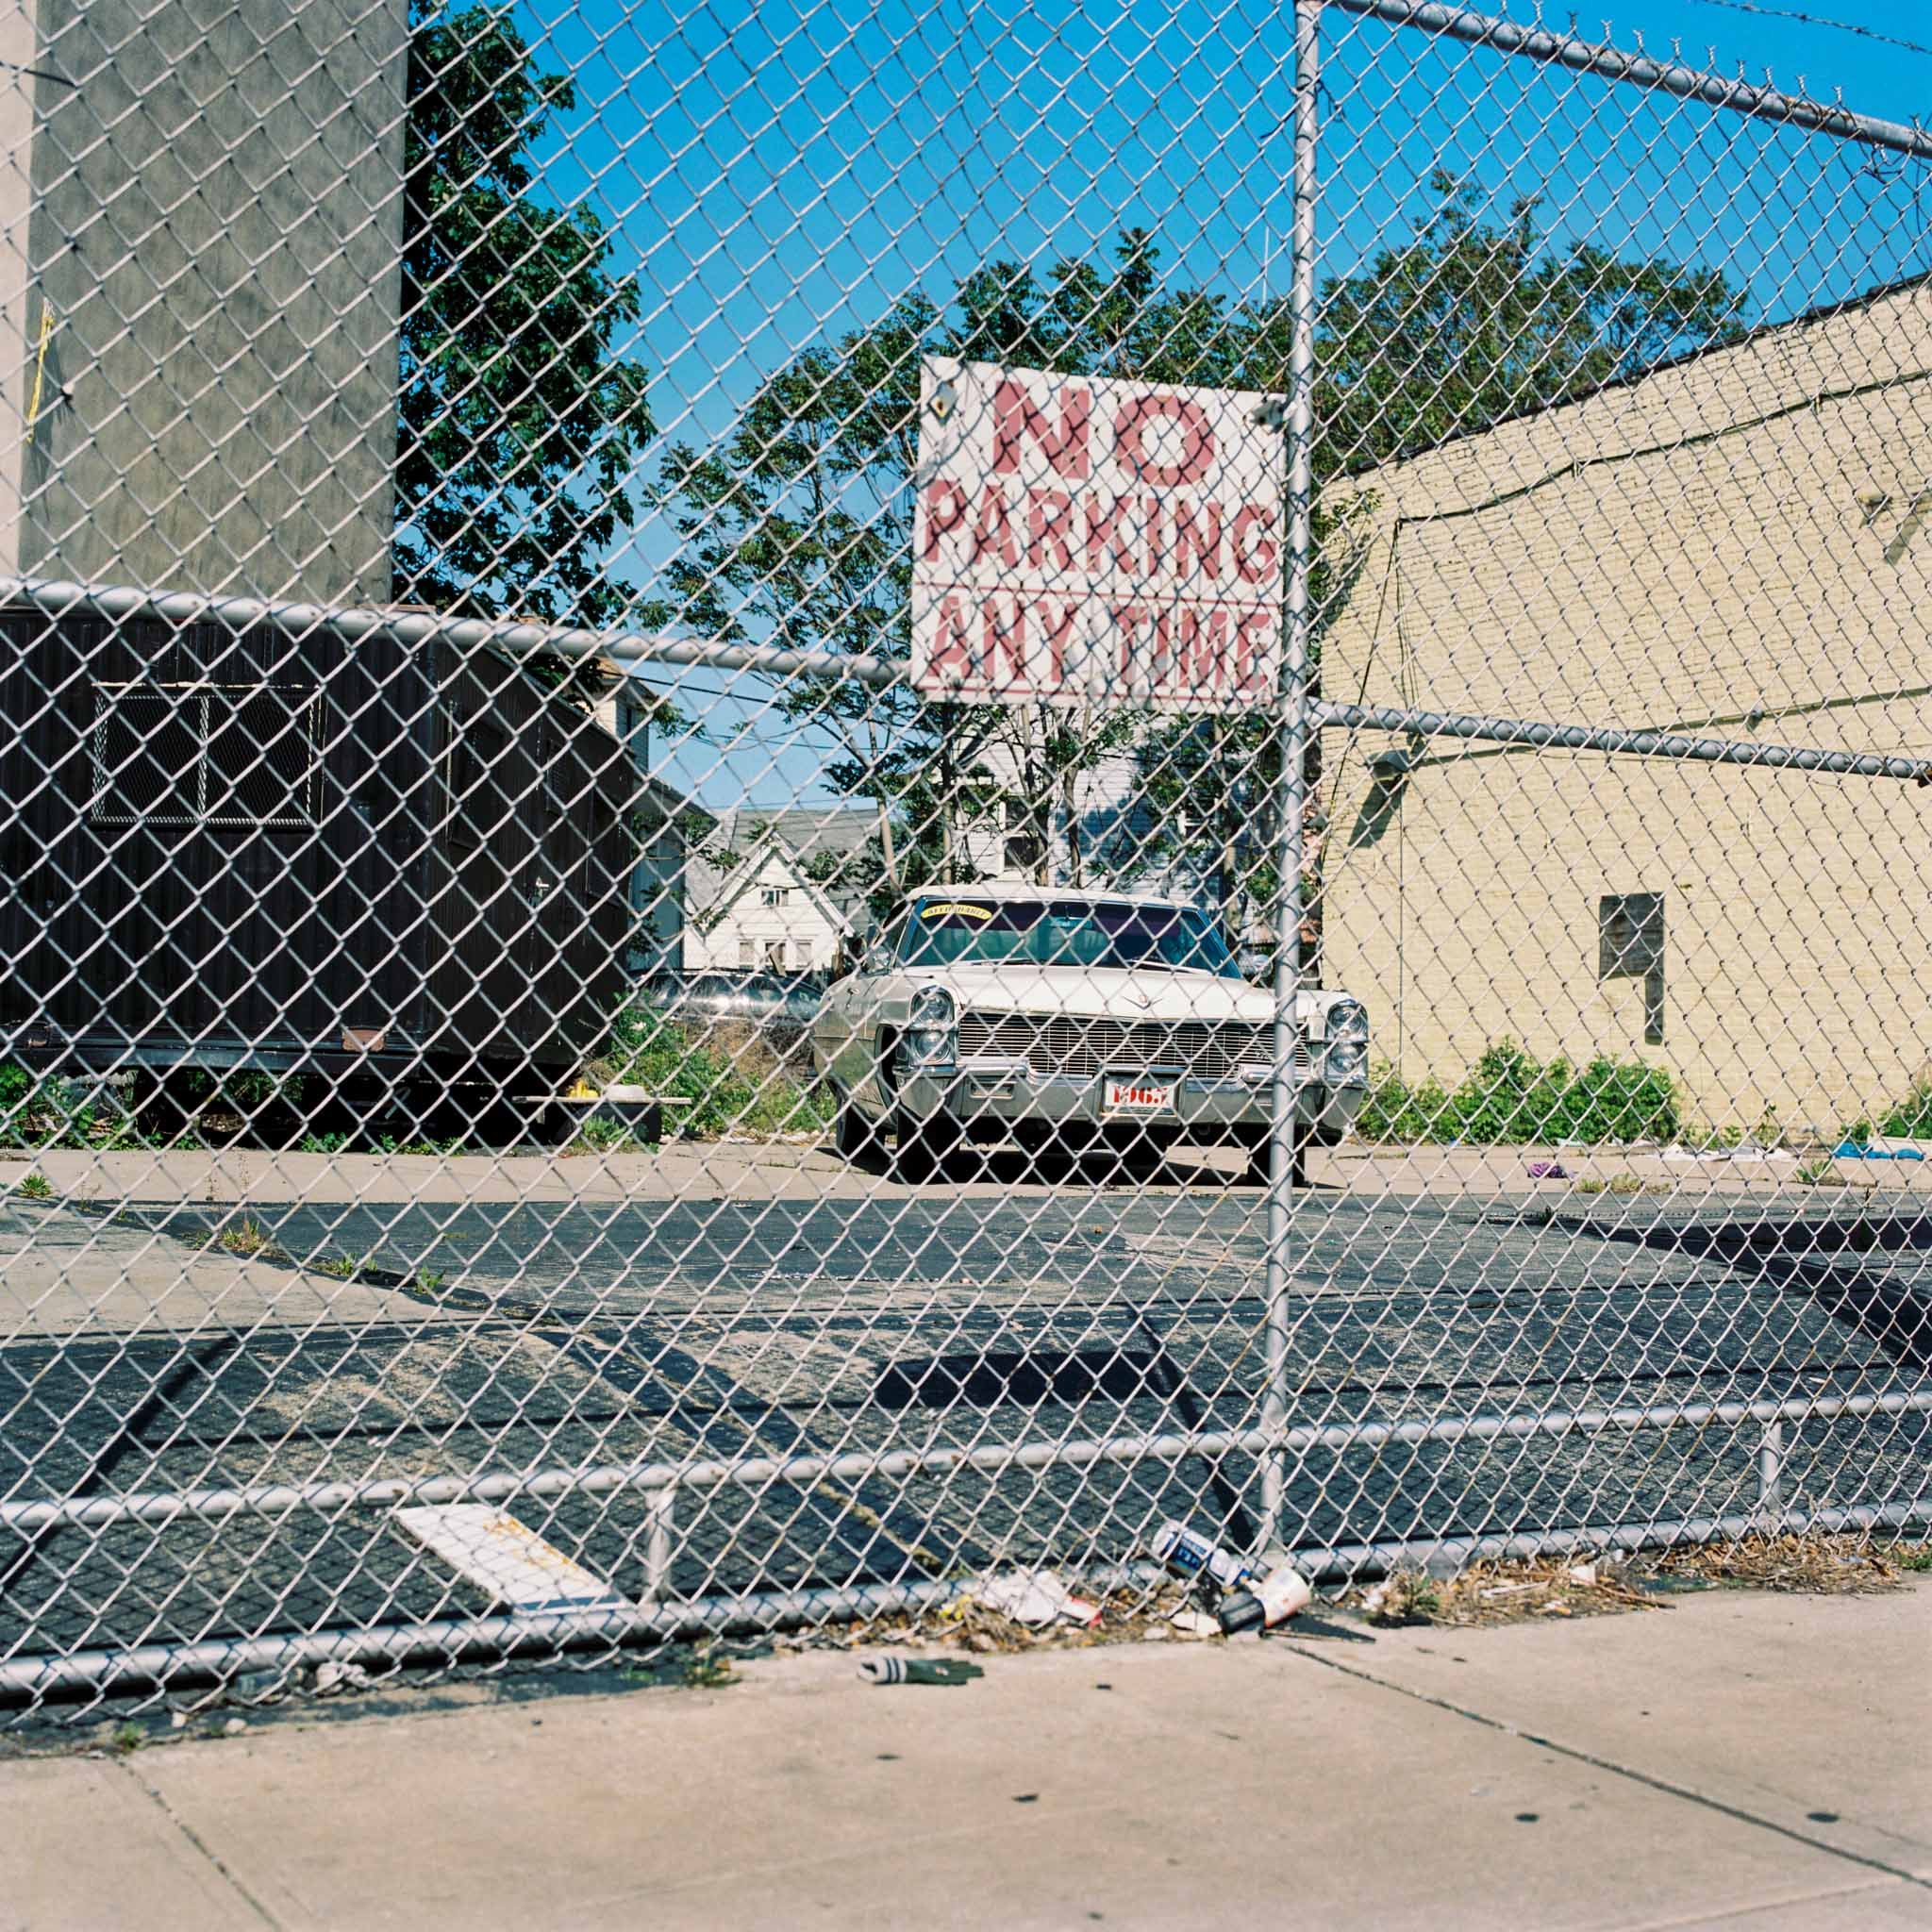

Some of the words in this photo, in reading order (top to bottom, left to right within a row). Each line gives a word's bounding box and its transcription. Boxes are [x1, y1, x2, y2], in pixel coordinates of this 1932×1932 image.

[991, 379, 1215, 487] NO
[924, 478, 1276, 585] PARKING
[927, 595, 1078, 683] ANY
[1113, 606, 1273, 691] TIME
